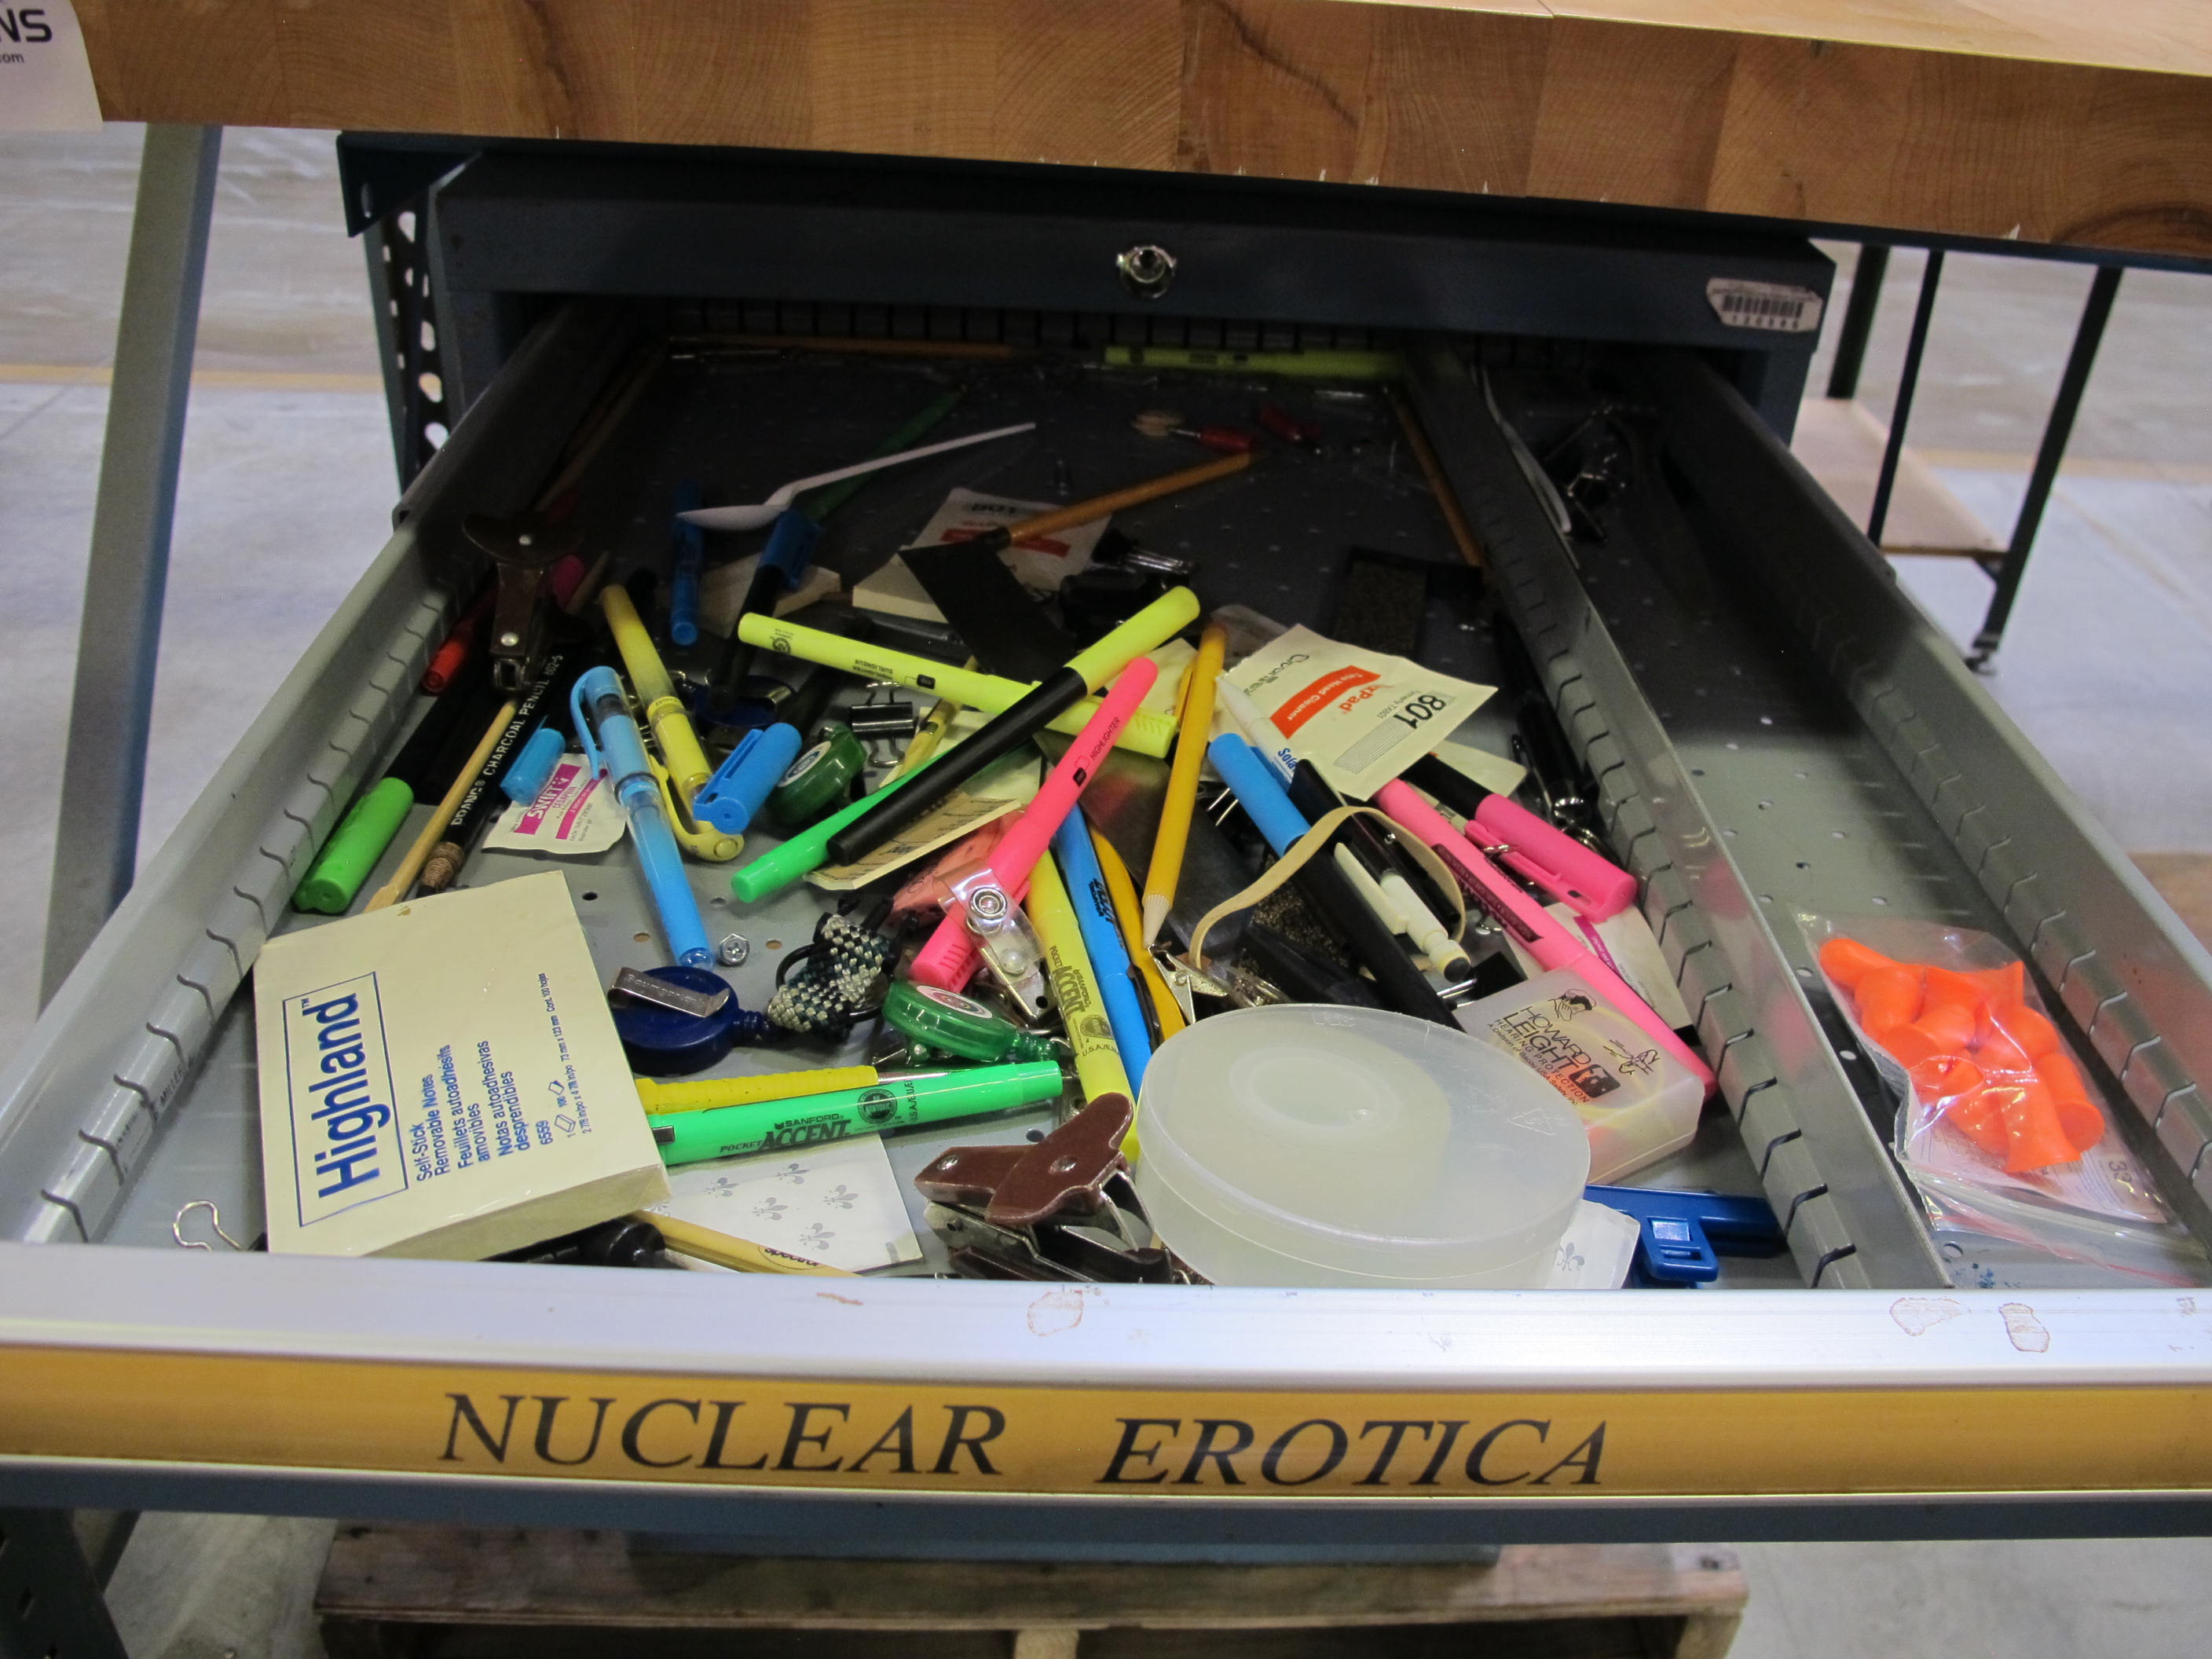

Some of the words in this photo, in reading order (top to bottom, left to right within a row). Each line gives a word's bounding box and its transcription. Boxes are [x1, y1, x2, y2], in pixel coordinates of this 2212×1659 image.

[483, 716, 527, 776] CHARCOAL
[518, 678, 550, 716] PENCIL
[1287, 695, 1320, 721] Cleaner
[1393, 694, 1447, 730] 801
[1090, 717, 1122, 761] HIGHLIGHTER
[527, 783, 563, 820] SWIFT
[1048, 945, 1063, 969] POCKET
[1052, 964, 1086, 1016] ACCENT
[1492, 1027, 1515, 1050] Division
[1494, 1017, 1533, 1060] HEARING
[1531, 1053, 1591, 1104] PROTECTION
[1503, 1011, 1579, 1071] LEIGHT
[1520, 1006, 1593, 1065] HOWARD
[303, 992, 391, 1199] Highland
[421, 1073, 439, 1109] Notes
[477, 1040, 506, 1119] autoadhesivas
[467, 1102, 491, 1163] amovibles
[500, 1071, 530, 1152] desprendibles
[536, 1119, 554, 1146] 6559
[720, 1141, 762, 1154] POCKET
[756, 1120, 851, 1152] ACCENT
[785, 1112, 840, 1128] SANFORD
[409, 1122, 433, 1181] Self-Stick
[425, 1108, 451, 1176] Removable
[453, 1117, 474, 1169] Feuillets
[496, 1120, 515, 1157] Notas
[436, 1392, 1006, 1476] NUCLEAR
[1093, 1417, 1608, 1487] EROTICA
